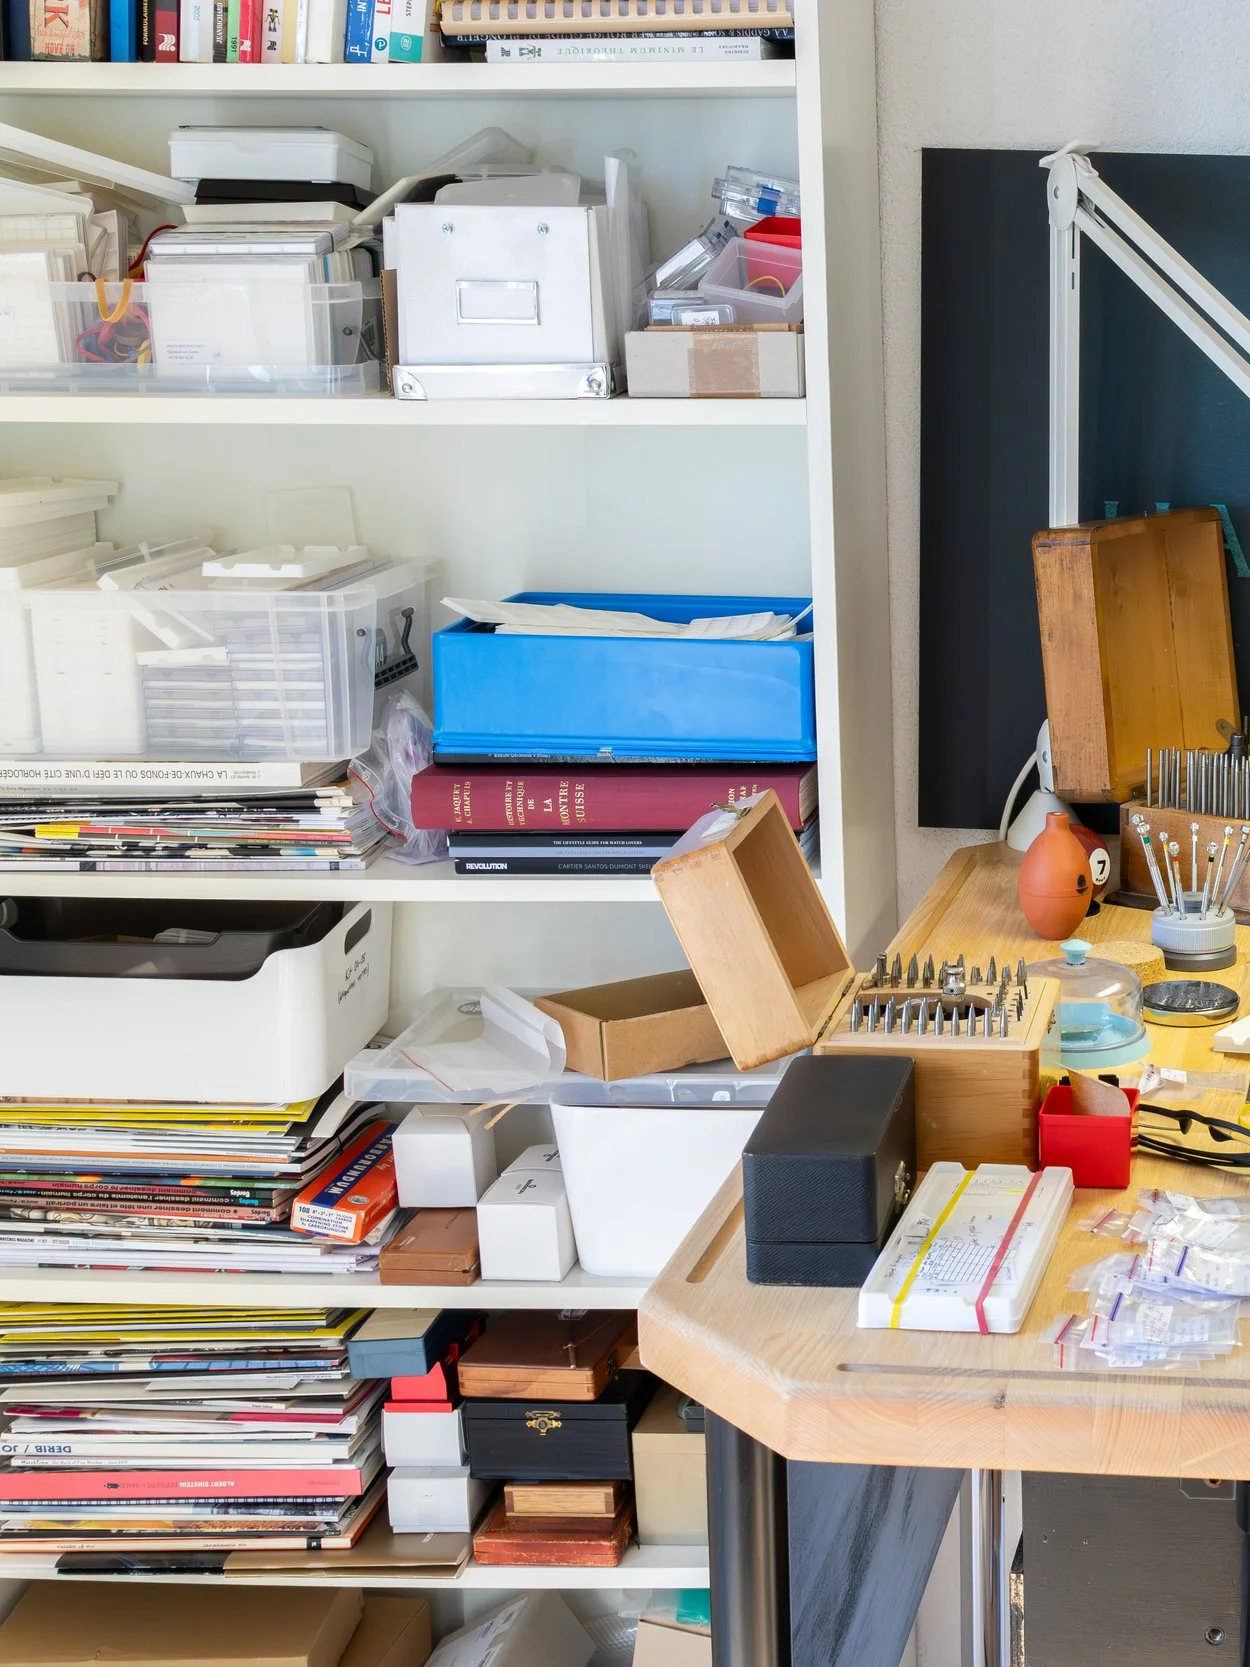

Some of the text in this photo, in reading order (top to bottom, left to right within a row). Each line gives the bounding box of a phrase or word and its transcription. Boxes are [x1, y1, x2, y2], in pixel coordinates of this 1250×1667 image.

[630, 46, 686, 54] MINIMUM
[43, 769, 62, 780] CITÉ
[64, 769, 91, 779] D'UNE
[92, 769, 111, 781] DÉFI
[113, 769, 123, 779] LE
[125, 769, 138, 779] OU
[140, 769, 214, 779] CHAUX-DE-FONDS
[216, 770, 228, 779] LA
[506, 780, 513, 791] ET
[453, 783, 462, 815] JAQUET
[463, 781, 472, 817] CHAPUIS
[516, 780, 526, 826] TECHNIQUE
[527, 798, 535, 810] DE
[559, 780, 570, 826] MONTRE
[575, 783, 587, 823] SUISSE
[543, 798, 553, 812] LA
[466, 862, 507, 870] REVOLUTION
[1097, 859, 1106, 875] 7
[124, 1185, 157, 1193] dessiner
[157, 1186, 197, 1194] comment
[230, 1189, 251, 1198] Bordas
[111, 1193, 153, 1201] l'anatomie
[154, 1194, 191, 1202] dessiner
[191, 1195, 230, 1203] comment
[239, 1198, 259, 1206] Bordas
[191, 1206, 231, 1214] comment
[251, 1208, 271, 1217] Bordas
[298, 1205, 311, 1214] 108
[300, 1217, 331, 1227] SHARPENING
[307, 1214, 343, 1225] COMBINATION
[308, 1222, 347, 1233] CARBORUNDUM
[24, 1444, 30, 1454] /
[34, 1445, 72, 1454] DERIB
[179, 1481, 209, 1489] EINSTEIN
[210, 1480, 235, 1488] ALBERT
